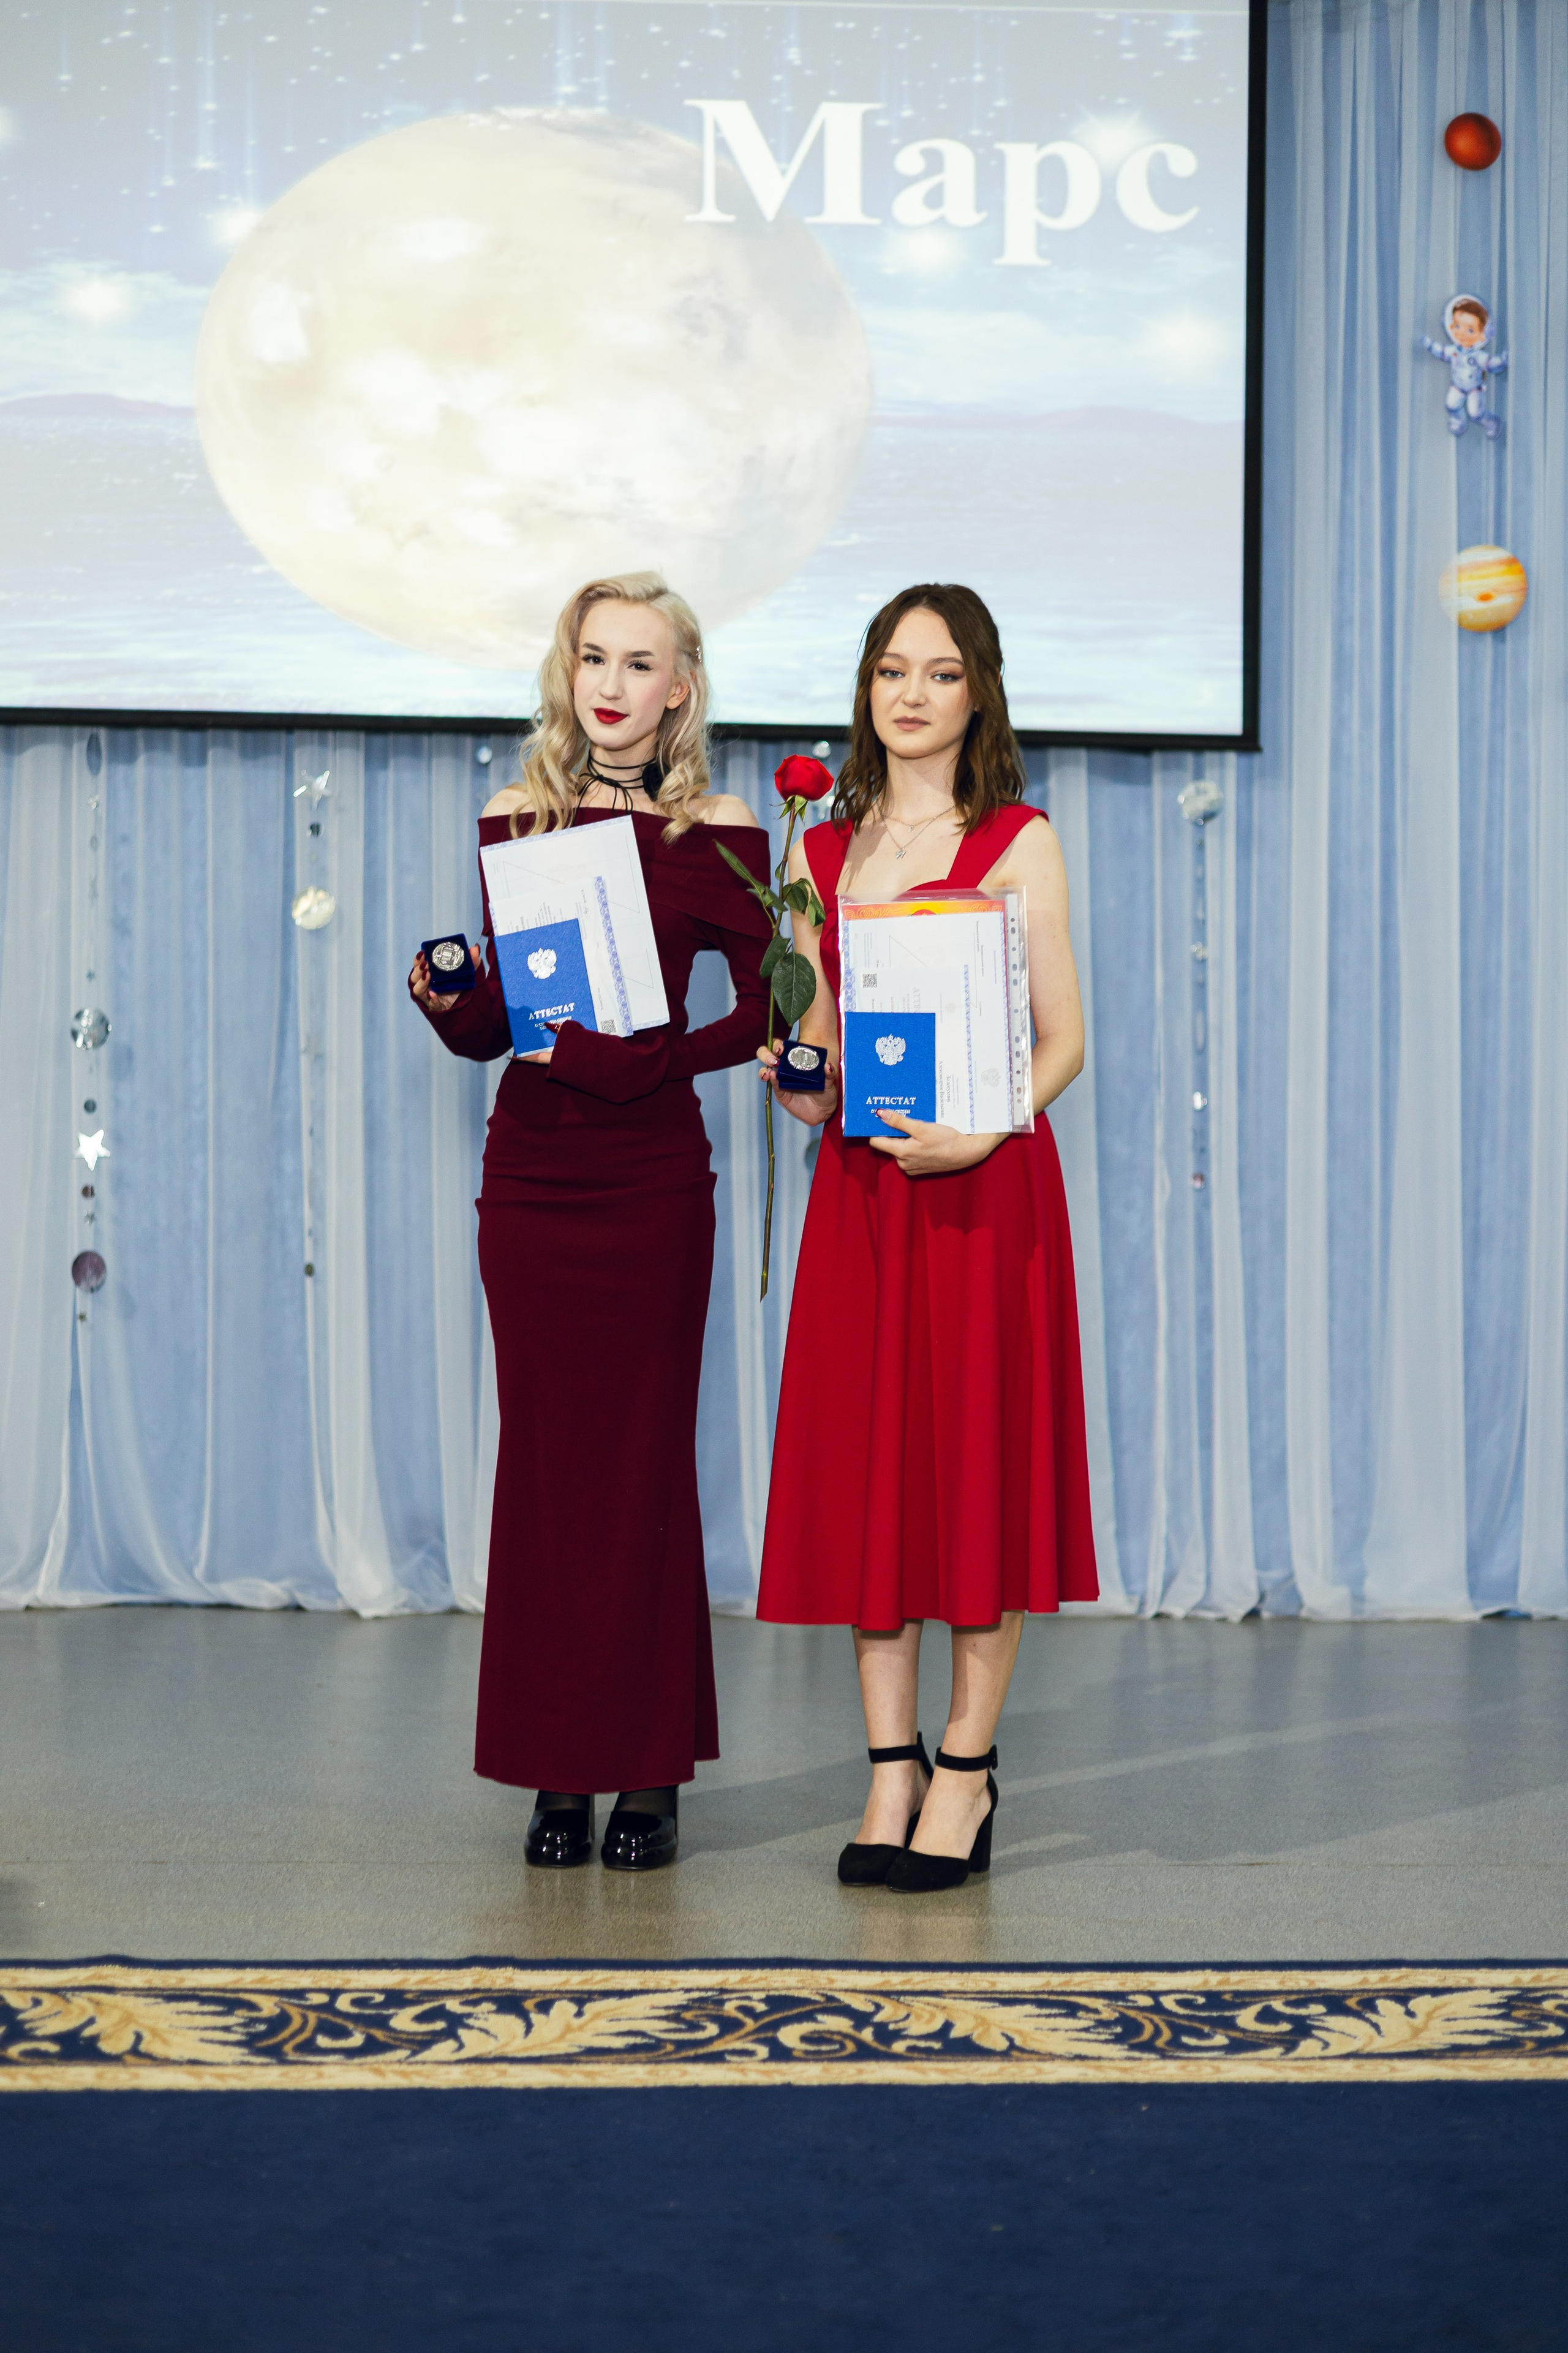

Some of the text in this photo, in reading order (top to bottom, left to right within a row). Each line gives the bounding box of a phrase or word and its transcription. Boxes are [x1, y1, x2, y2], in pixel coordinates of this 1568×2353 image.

[683, 99, 1200, 266] Марс
[529, 1002, 575, 1021] АТТЕСТАТ
[865, 1095, 916, 1105] АТТЕСТАТ
